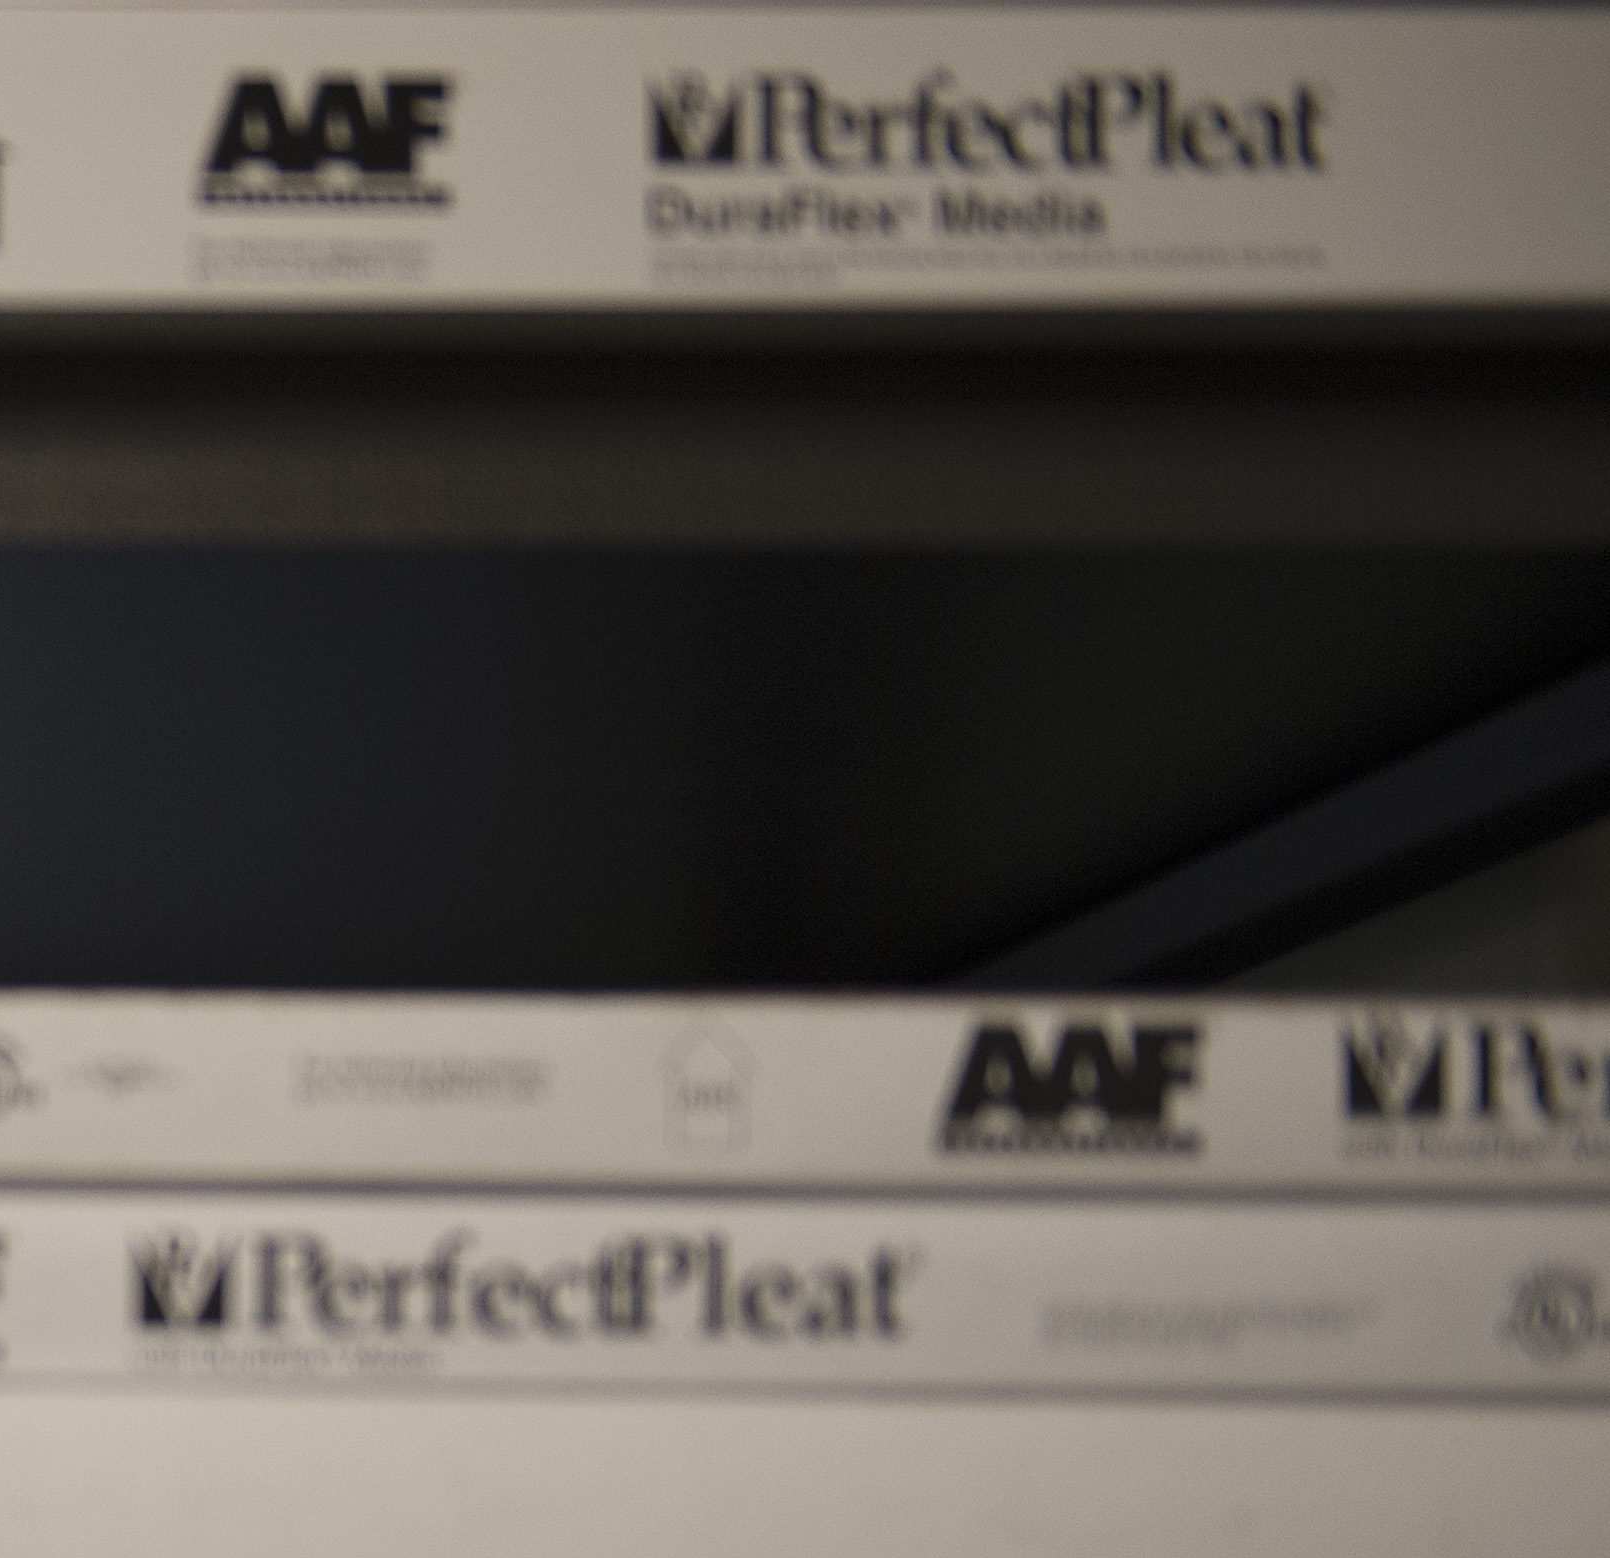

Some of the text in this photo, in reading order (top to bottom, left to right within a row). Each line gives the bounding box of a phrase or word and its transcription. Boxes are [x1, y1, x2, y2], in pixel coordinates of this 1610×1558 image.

[205, 73, 454, 175] AAF
[944, 1024, 1204, 1124] AAF
[247, 1225, 912, 1343] PerfectPleat
